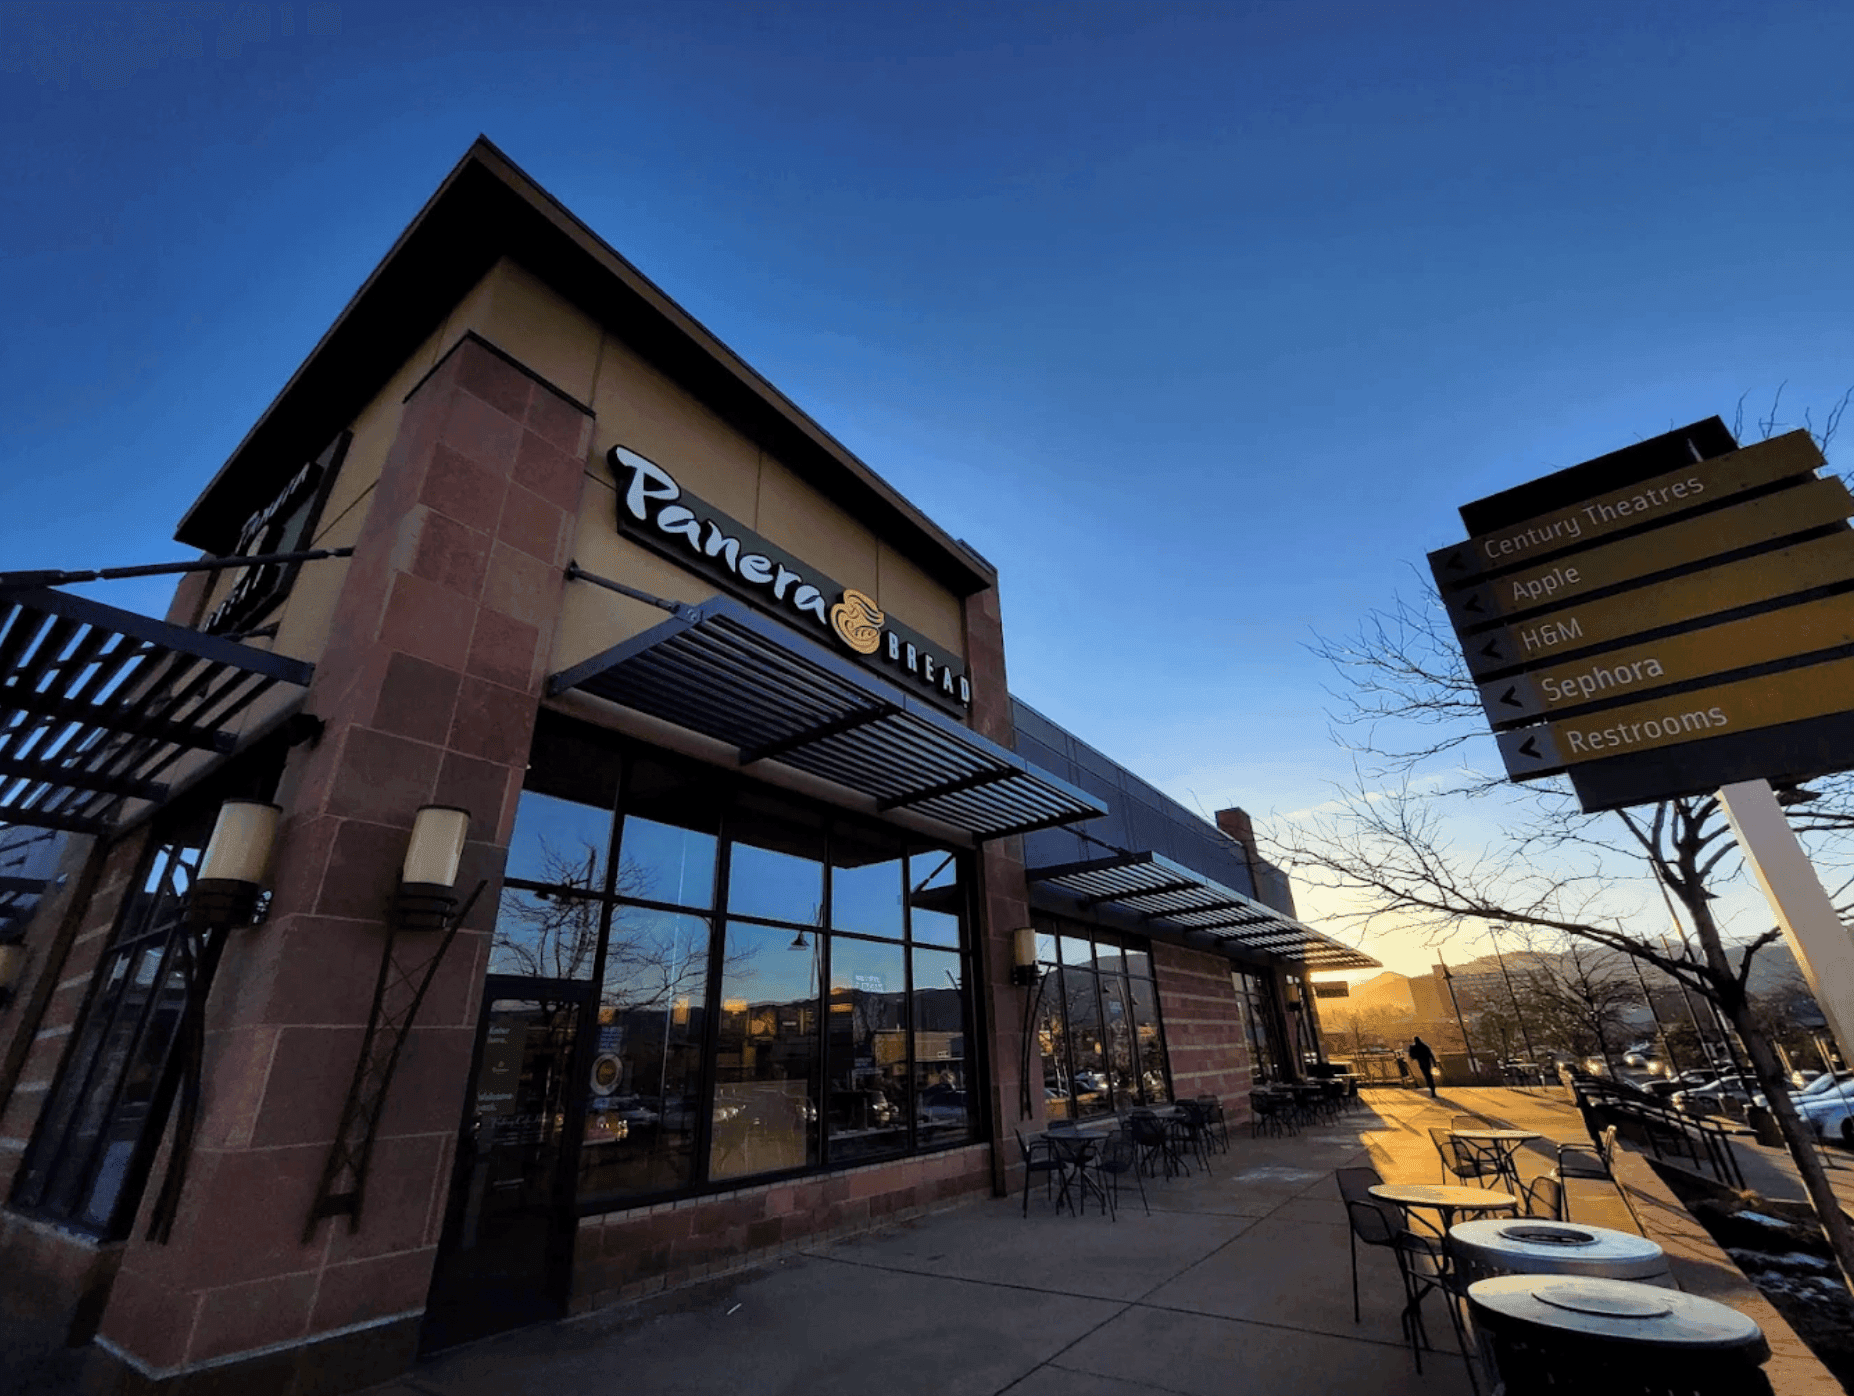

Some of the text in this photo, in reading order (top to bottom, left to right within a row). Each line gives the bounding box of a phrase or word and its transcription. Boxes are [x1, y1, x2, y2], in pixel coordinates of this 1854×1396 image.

[1484, 477, 1704, 559] Century Theatres
[615, 446, 970, 703] Panera BREAD
[1511, 565, 1581, 600] Apple
[1521, 617, 1583, 651] H&M
[1541, 656, 1664, 702] Sephora
[1566, 706, 1728, 754] Restrooms
